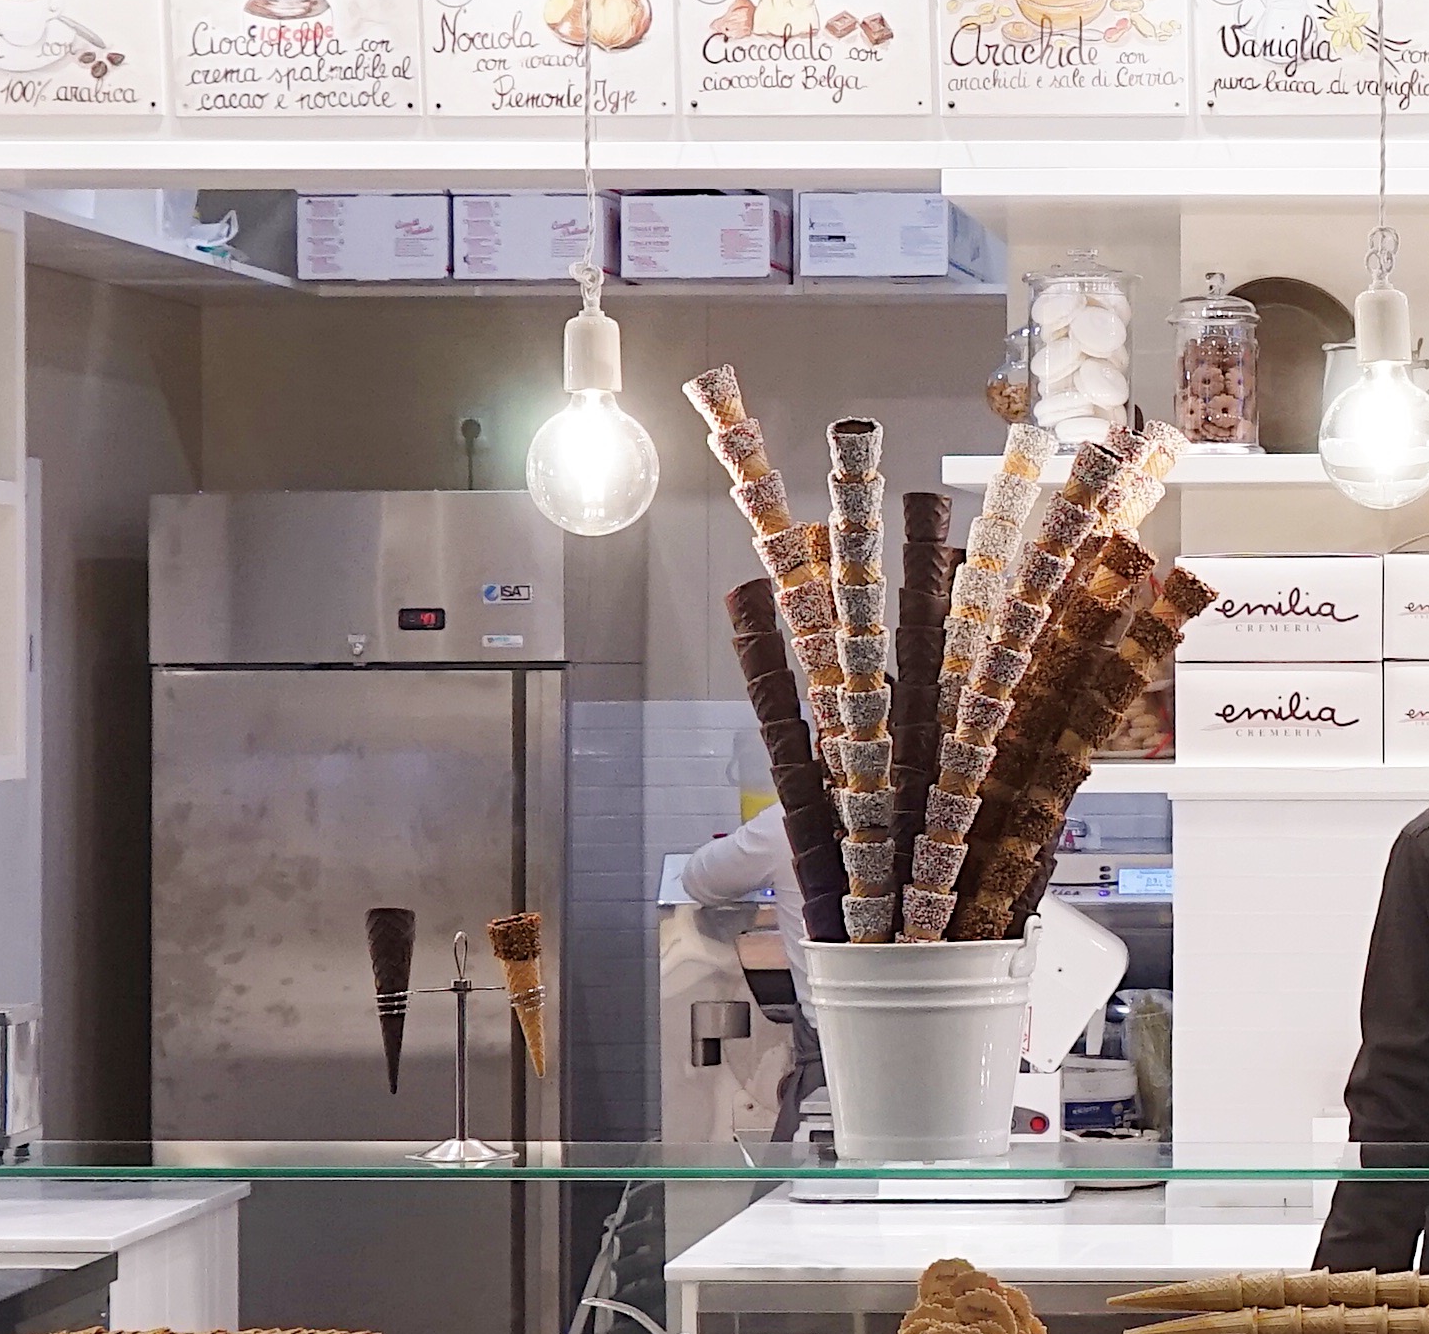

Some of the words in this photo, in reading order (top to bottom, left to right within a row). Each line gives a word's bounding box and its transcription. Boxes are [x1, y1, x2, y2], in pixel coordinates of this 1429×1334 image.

[353, 38, 394, 54] con
[433, 10, 541, 55] Nocciola
[702, 23, 833, 66] Cioccolato
[845, 47, 883, 62] con
[944, 16, 1099, 69] Arachide
[1115, 49, 1150, 65] con
[1219, 14, 1342, 77] Vaniglia
[184, 67, 262, 86] crema
[385, 57, 415, 81] al
[473, 53, 511, 72] con
[0, 80, 48, 105] 100%
[51, 80, 140, 105] arabica
[491, 74, 584, 112] Piemonte
[699, 66, 796, 93] cioccolato
[802, 65, 867, 103] Belga
[947, 70, 1031, 92] arachidi
[1049, 69, 1088, 89] sale
[1092, 68, 1110, 88] di
[1208, 74, 1261, 103] pura
[1263, 69, 1324, 95] bacca
[1326, 68, 1348, 95] di
[194, 89, 269, 112] cacao
[276, 93, 288, 111] e
[298, 86, 398, 111] nocciole
[501, 585, 521, 597] ISA
[1215, 587, 1359, 623] emilia
[1235, 624, 1322, 632] CREMERIA
[1215, 692, 1359, 728] emilia
[1235, 728, 1322, 737] CREMERIA
